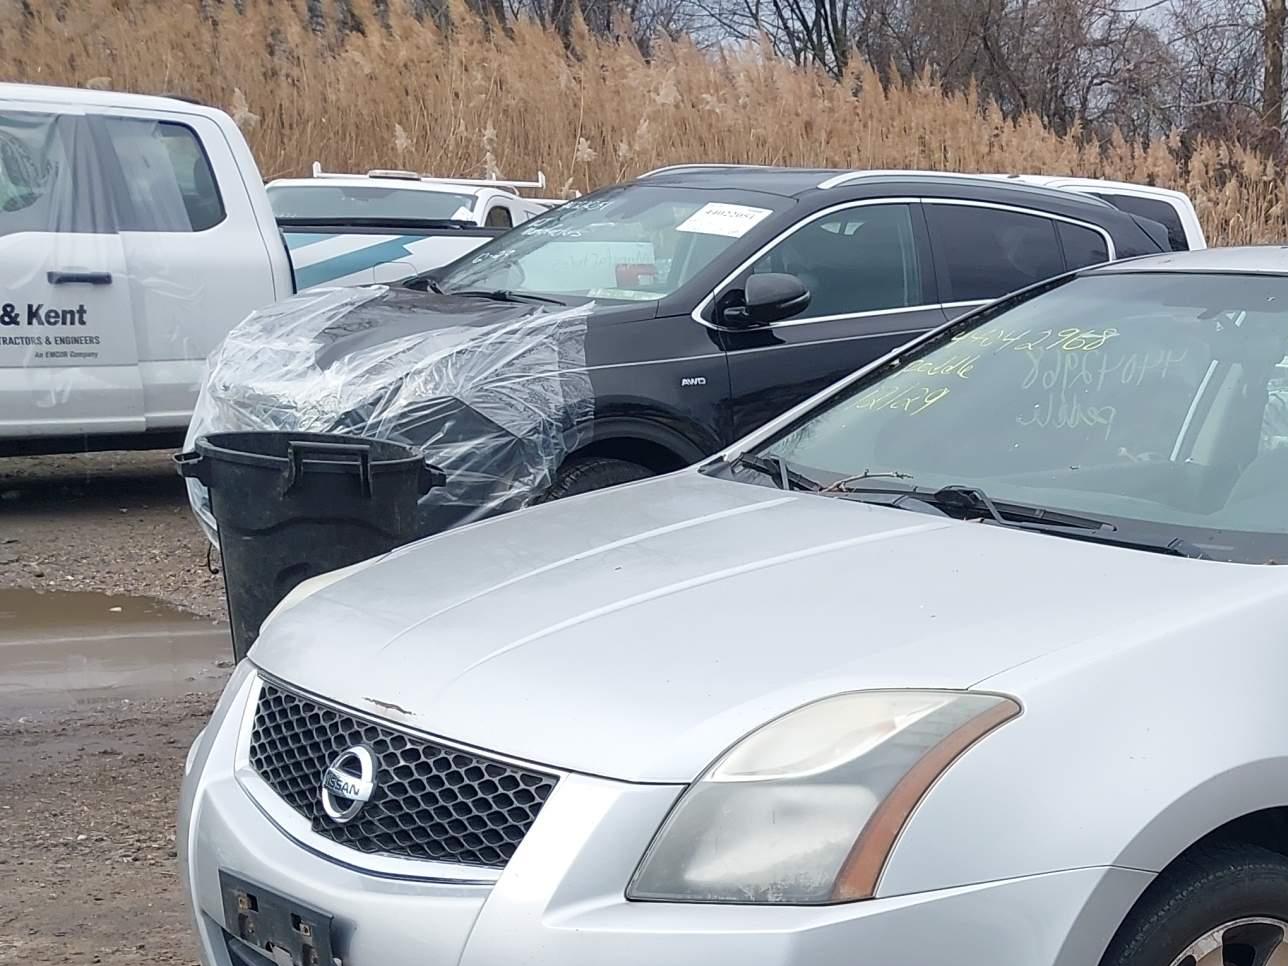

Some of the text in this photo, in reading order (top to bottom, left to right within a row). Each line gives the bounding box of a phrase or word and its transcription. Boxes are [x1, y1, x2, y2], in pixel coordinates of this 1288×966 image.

[0, 303, 87, 326] & Kent
[0, 336, 100, 345] RACTORS & ENGINEERS
[681, 377, 707, 387] AWD
